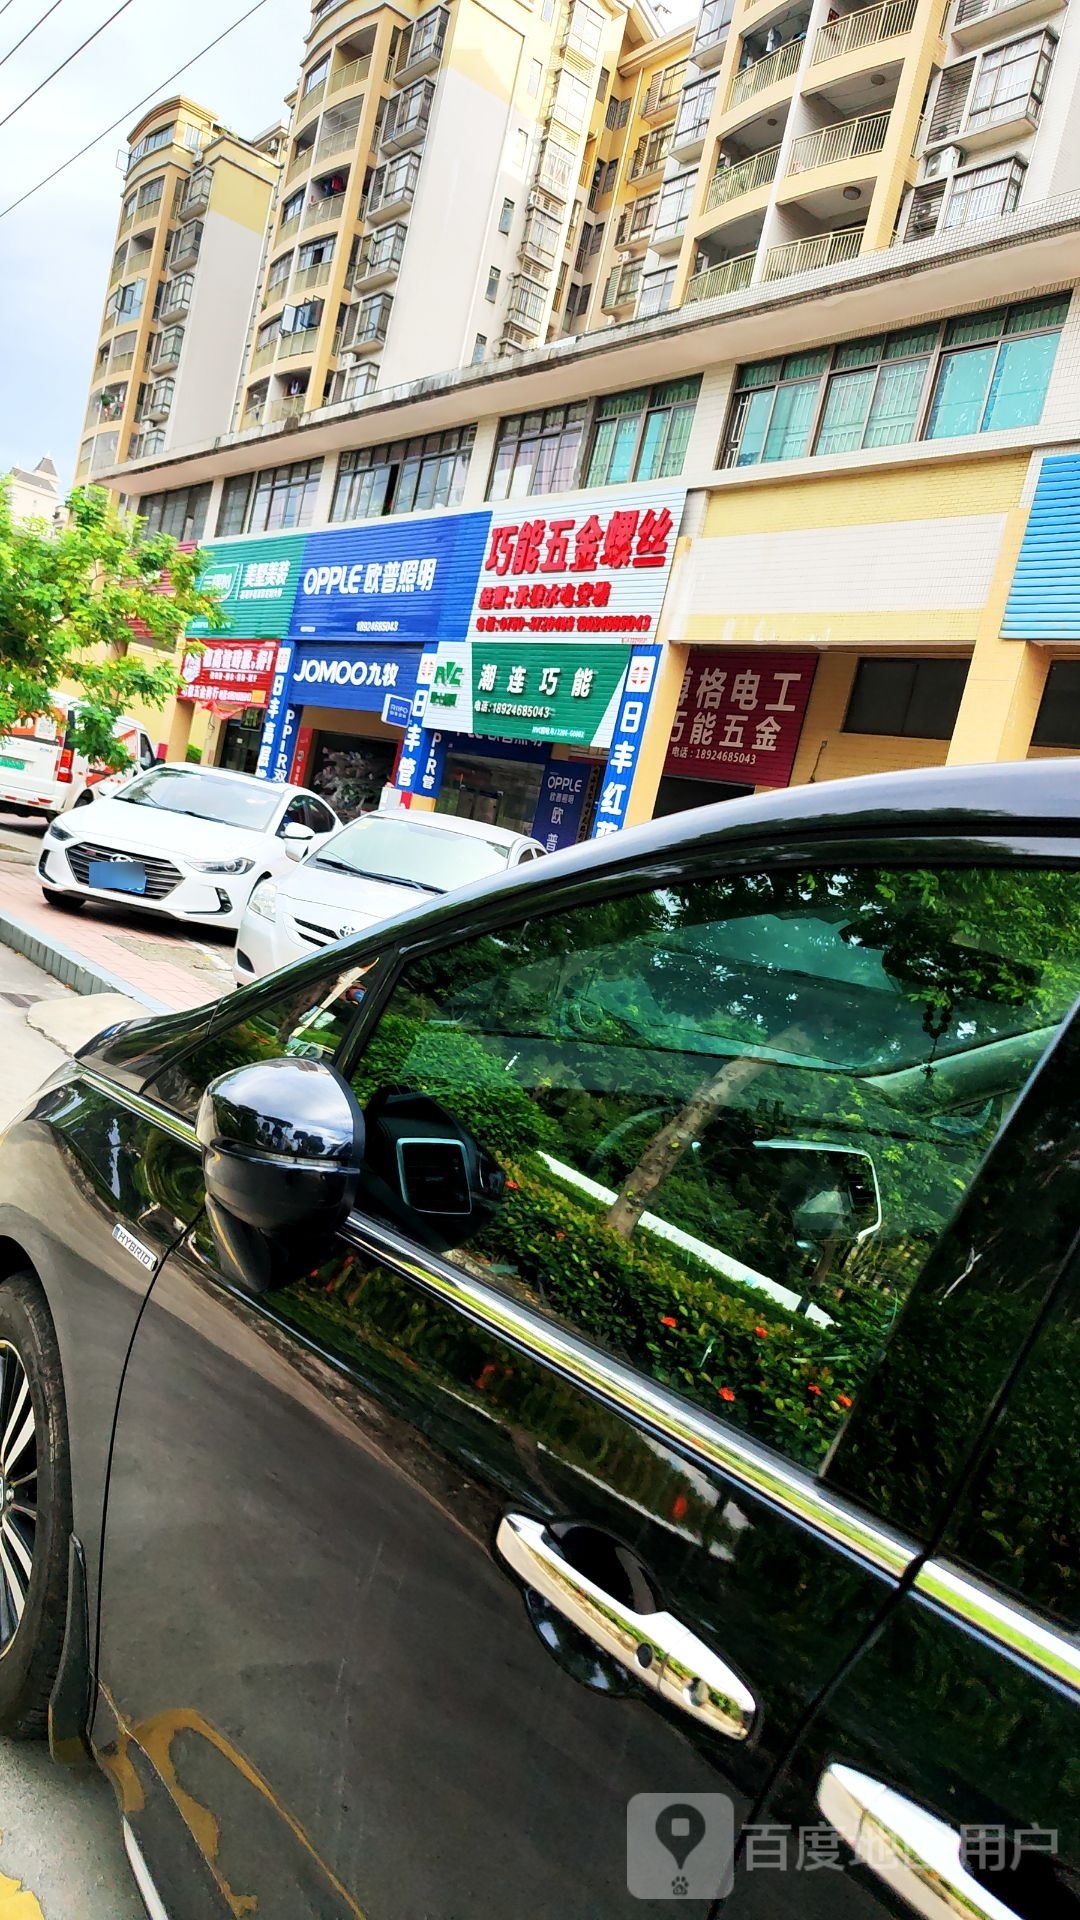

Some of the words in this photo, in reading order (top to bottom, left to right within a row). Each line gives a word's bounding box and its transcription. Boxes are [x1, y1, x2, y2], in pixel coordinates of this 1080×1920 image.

[485, 507, 673, 576] 巧能五金螺丝
[303, 564, 363, 595] OPPLE
[363, 558, 437, 594] 欧普照明
[477, 663, 594, 698] 潮连巧能
[547, 776, 582, 792] OPPLE
[117, 1230, 151, 1265] HYBRID
